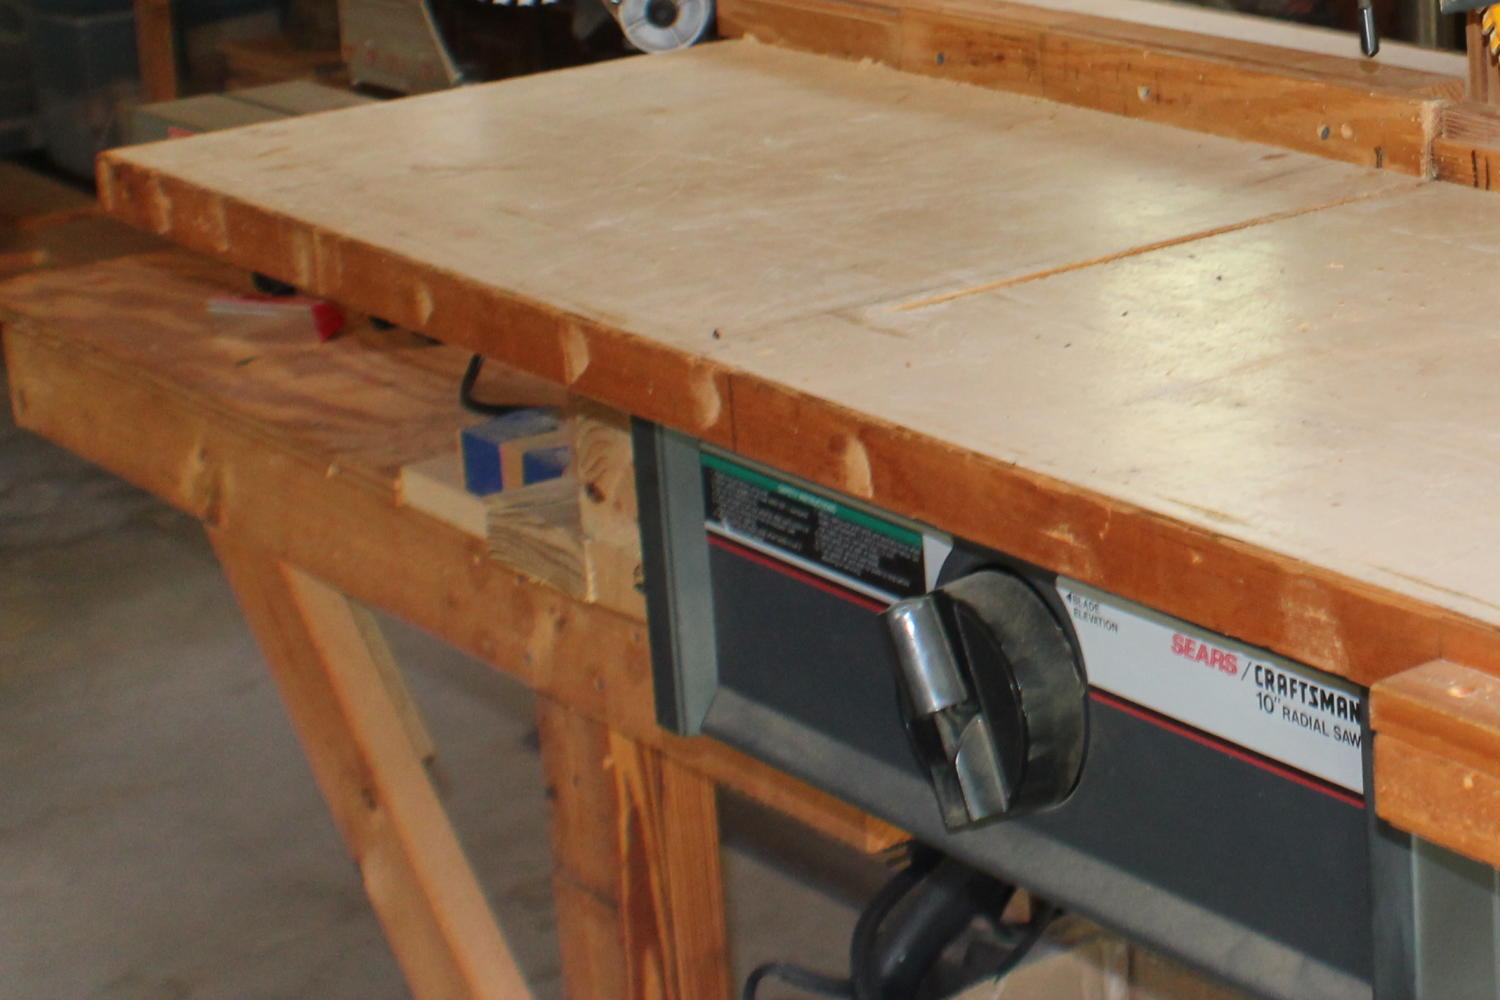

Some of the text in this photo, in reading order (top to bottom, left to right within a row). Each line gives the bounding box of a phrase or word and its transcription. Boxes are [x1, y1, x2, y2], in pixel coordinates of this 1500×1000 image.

[1072, 592, 1099, 612] BLADE
[1073, 607, 1118, 633] ELEVATION
[1172, 633, 1238, 676] SEARS
[1254, 664, 1361, 725] CRAFTSMAN
[1256, 691, 1361, 750] 10" RADIAL SAW
